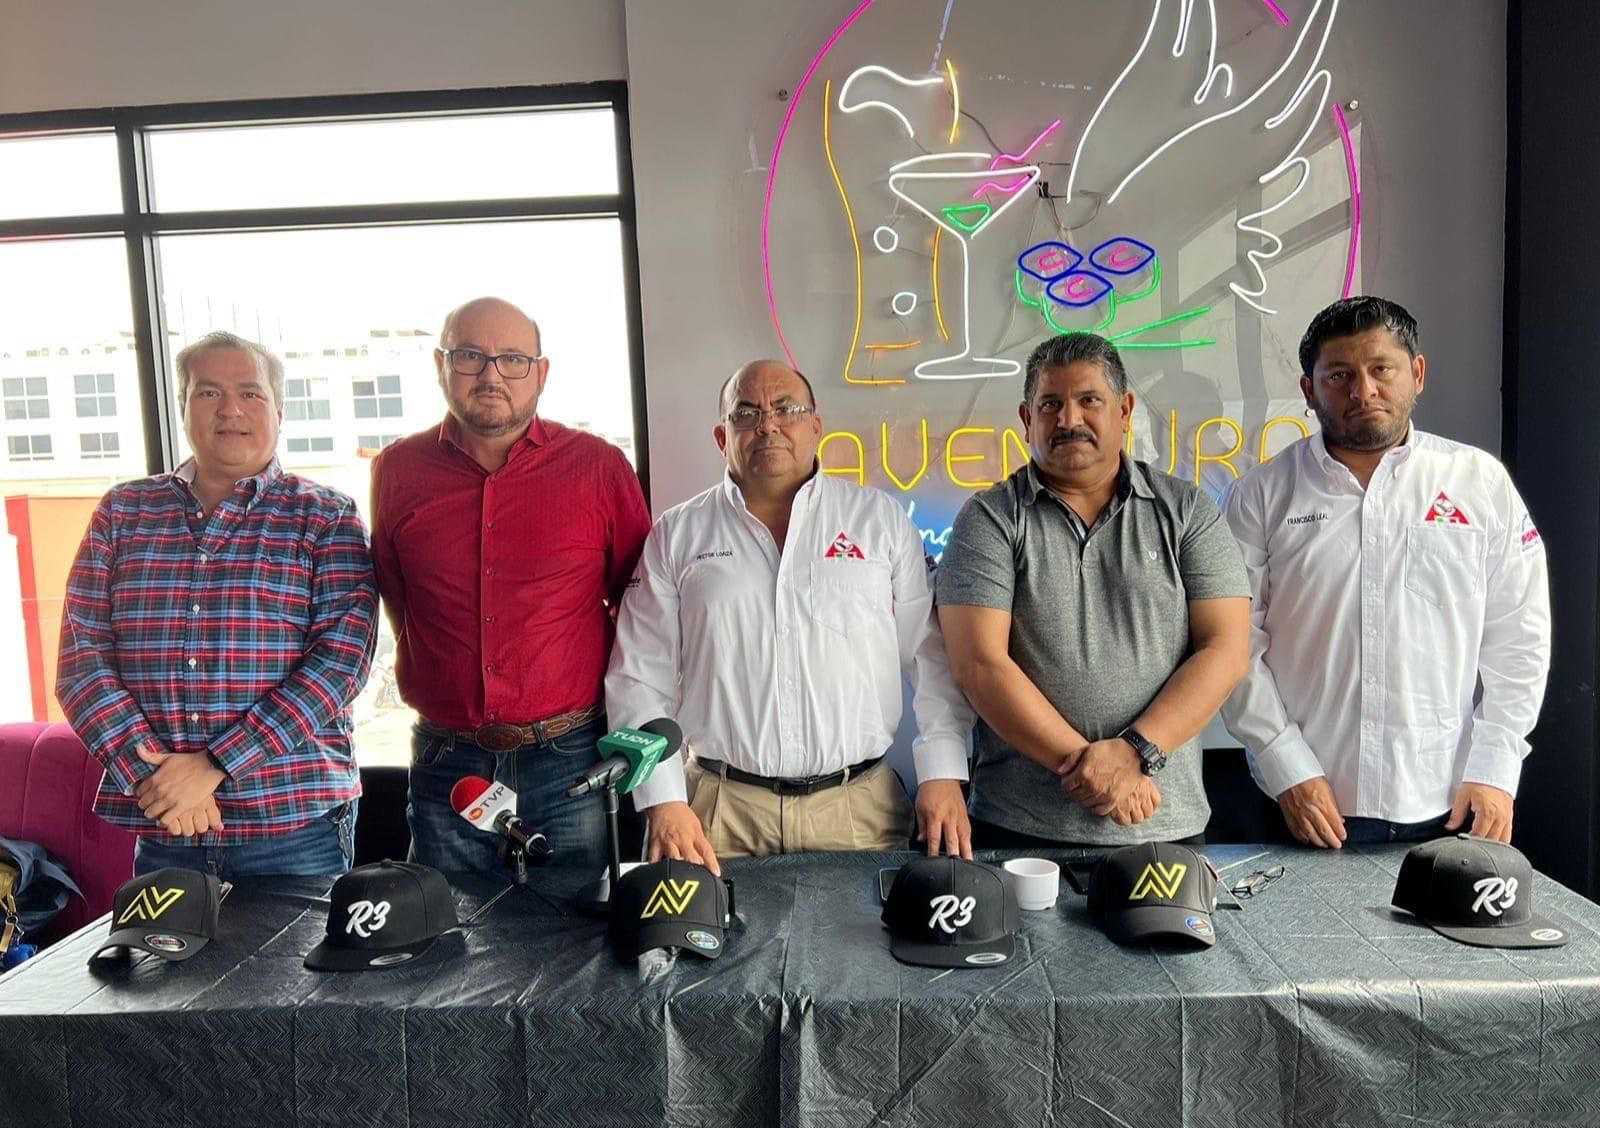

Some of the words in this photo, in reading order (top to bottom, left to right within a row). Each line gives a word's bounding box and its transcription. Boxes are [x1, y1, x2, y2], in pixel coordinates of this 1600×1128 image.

[1287, 514, 1316, 526] FRANCISCO
[613, 731, 654, 745] TUDN
[480, 786, 505, 808] TVP
[1471, 877, 1519, 917] R3
[345, 900, 391, 938] R3
[928, 894, 977, 934] R3
